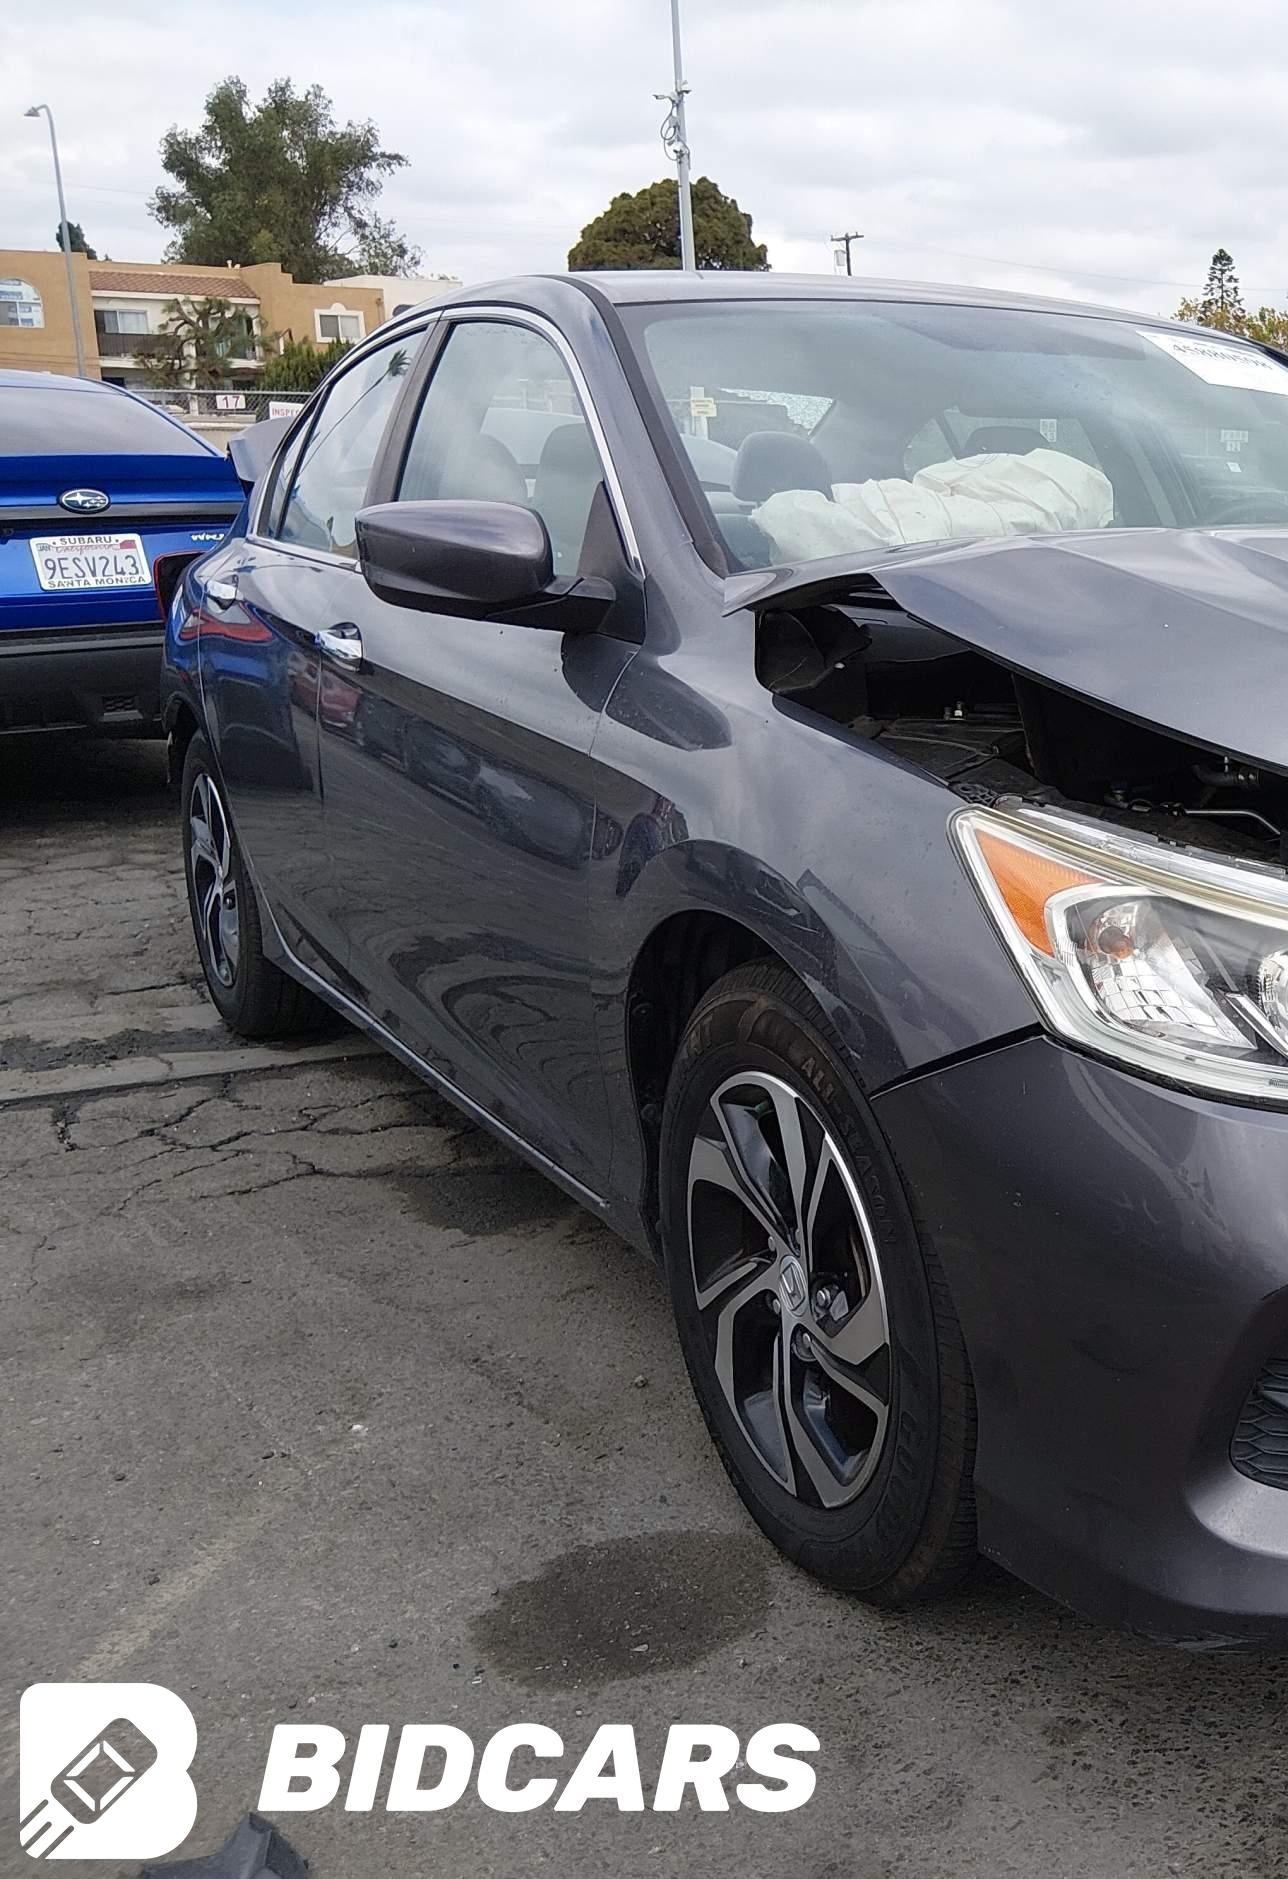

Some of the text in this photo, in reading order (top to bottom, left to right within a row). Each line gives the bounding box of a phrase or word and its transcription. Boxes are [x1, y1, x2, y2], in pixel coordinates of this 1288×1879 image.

[222, 396, 240, 409] 17
[59, 536, 112, 545] SUBARU
[44, 555, 140, 580] 9ESV243
[48, 576, 146, 589] SANTA MONICA
[800, 1055, 836, 1105] ALL
